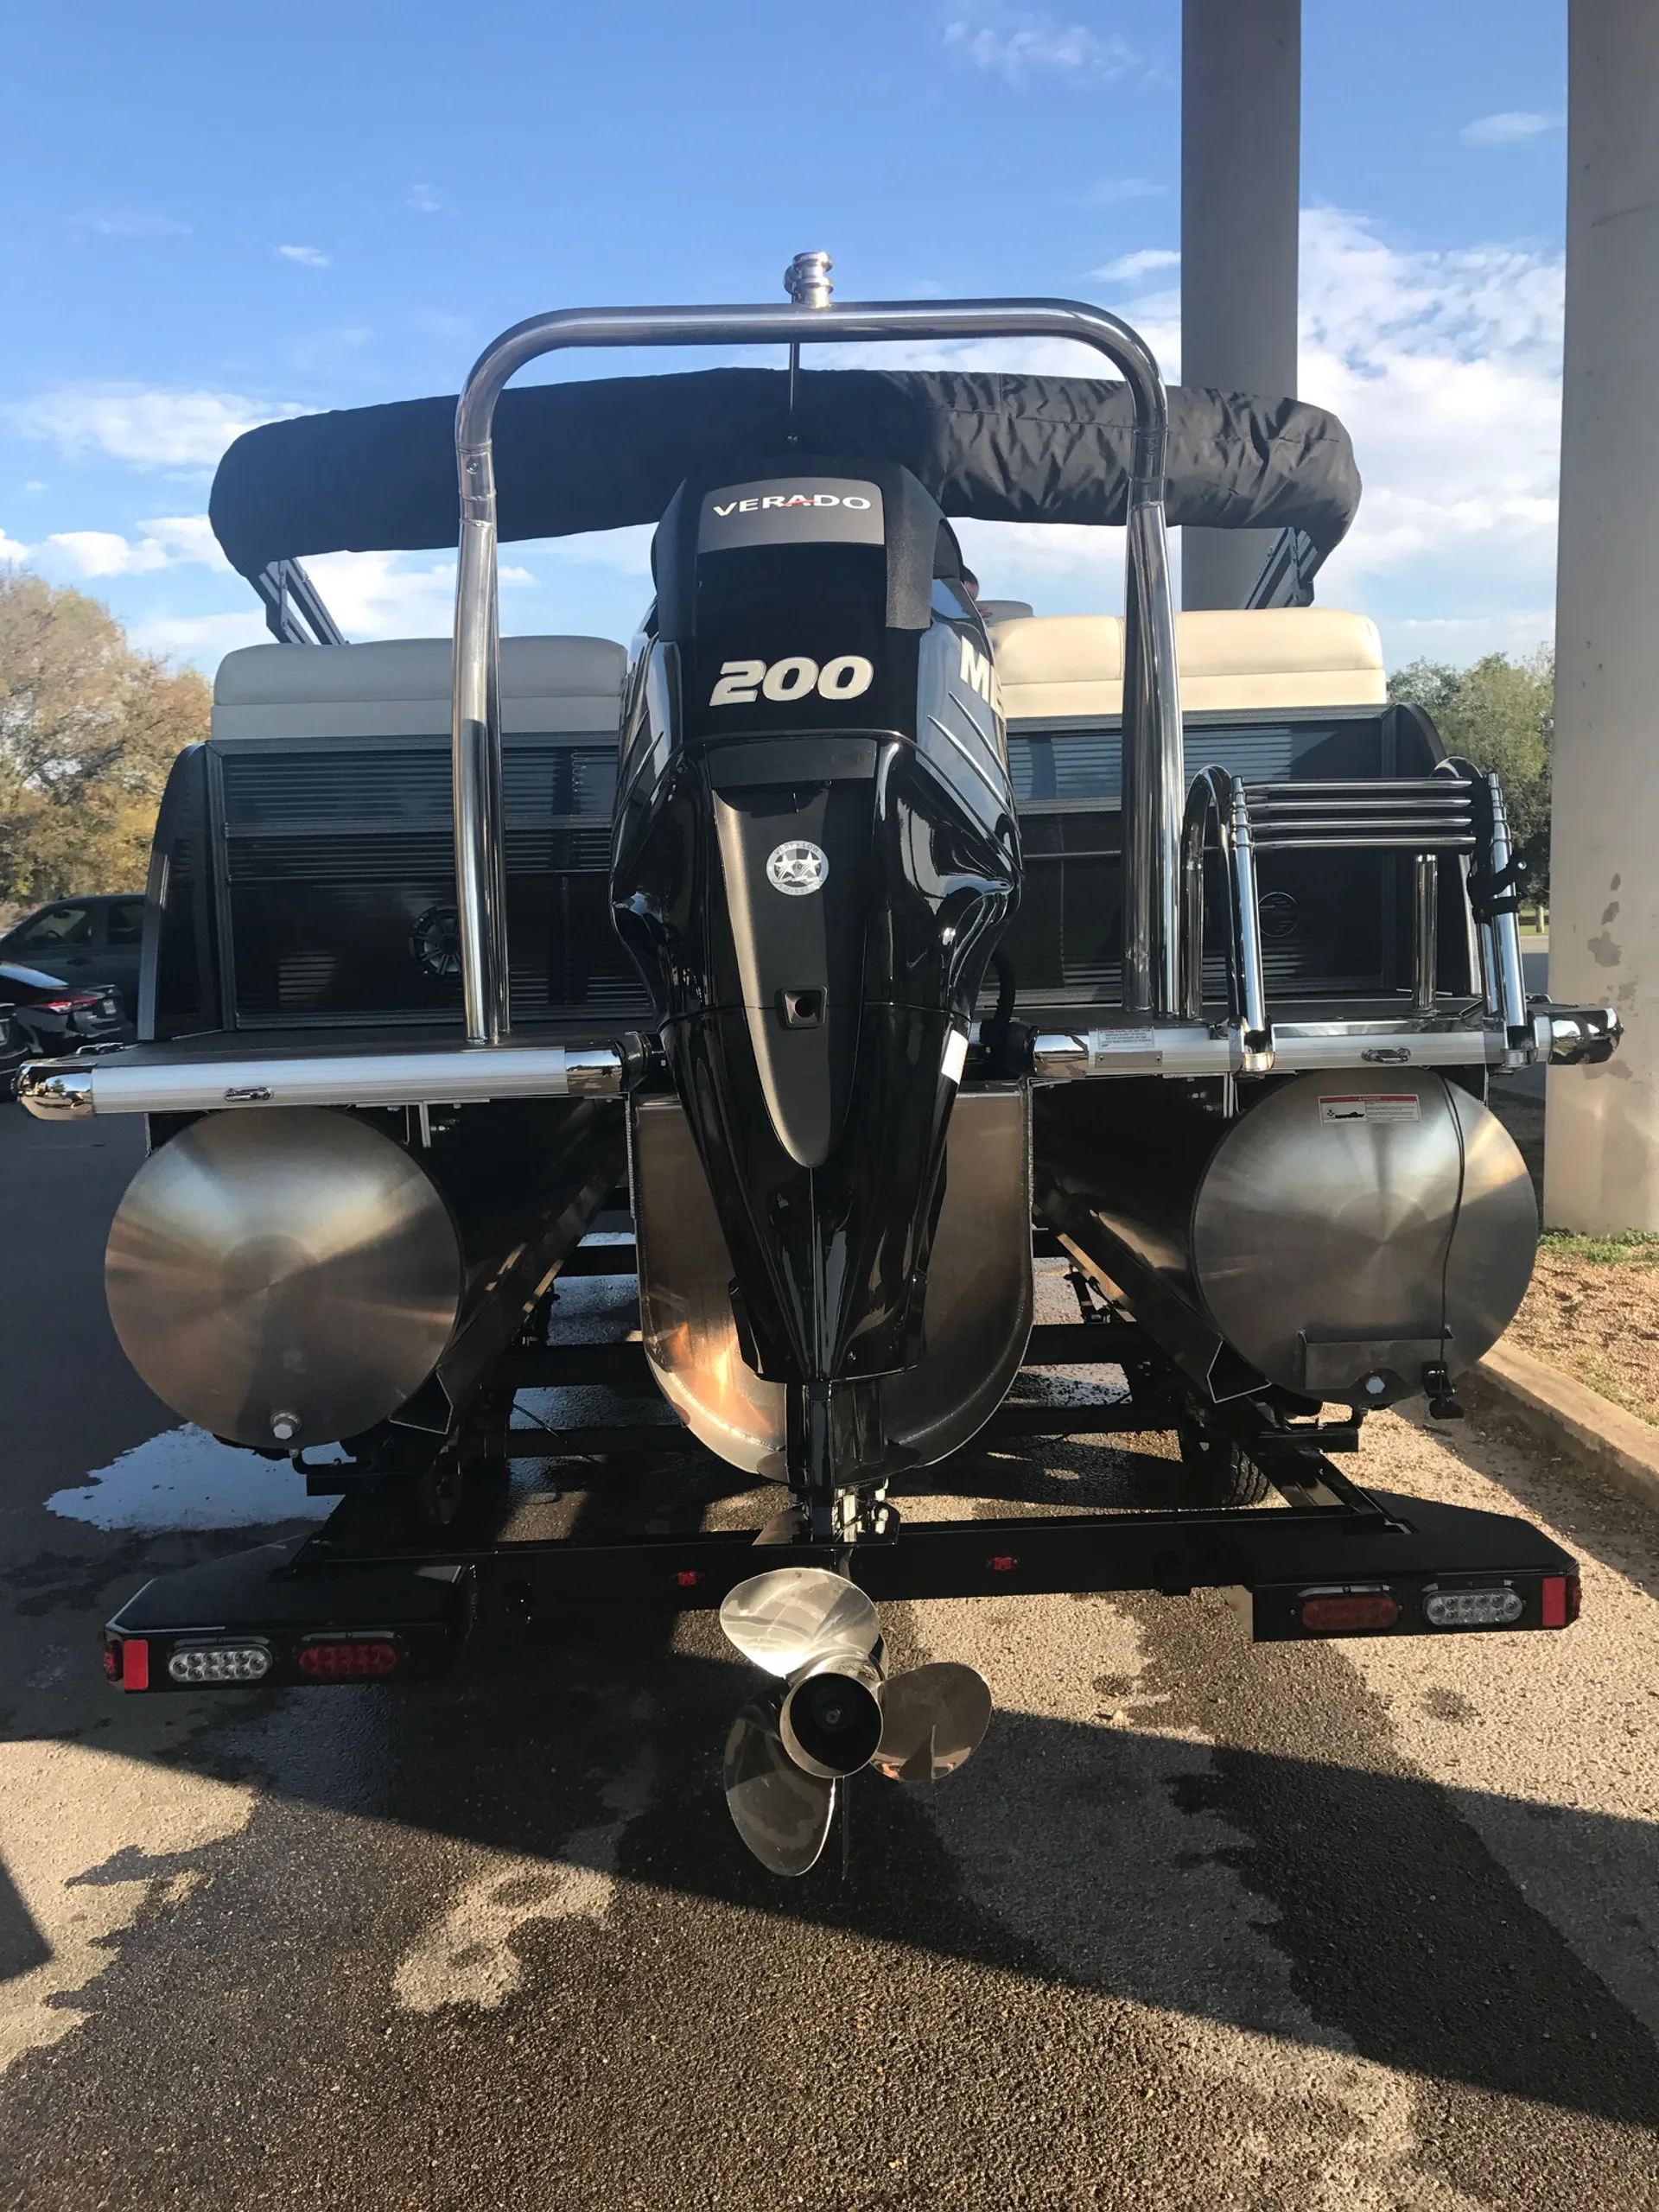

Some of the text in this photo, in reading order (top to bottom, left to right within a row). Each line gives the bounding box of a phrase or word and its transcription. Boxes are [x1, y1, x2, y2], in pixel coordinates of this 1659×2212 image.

[713, 494, 873, 518] VERADO
[709, 655, 874, 707] 200
[774, 843, 820, 855] VERY LOW
